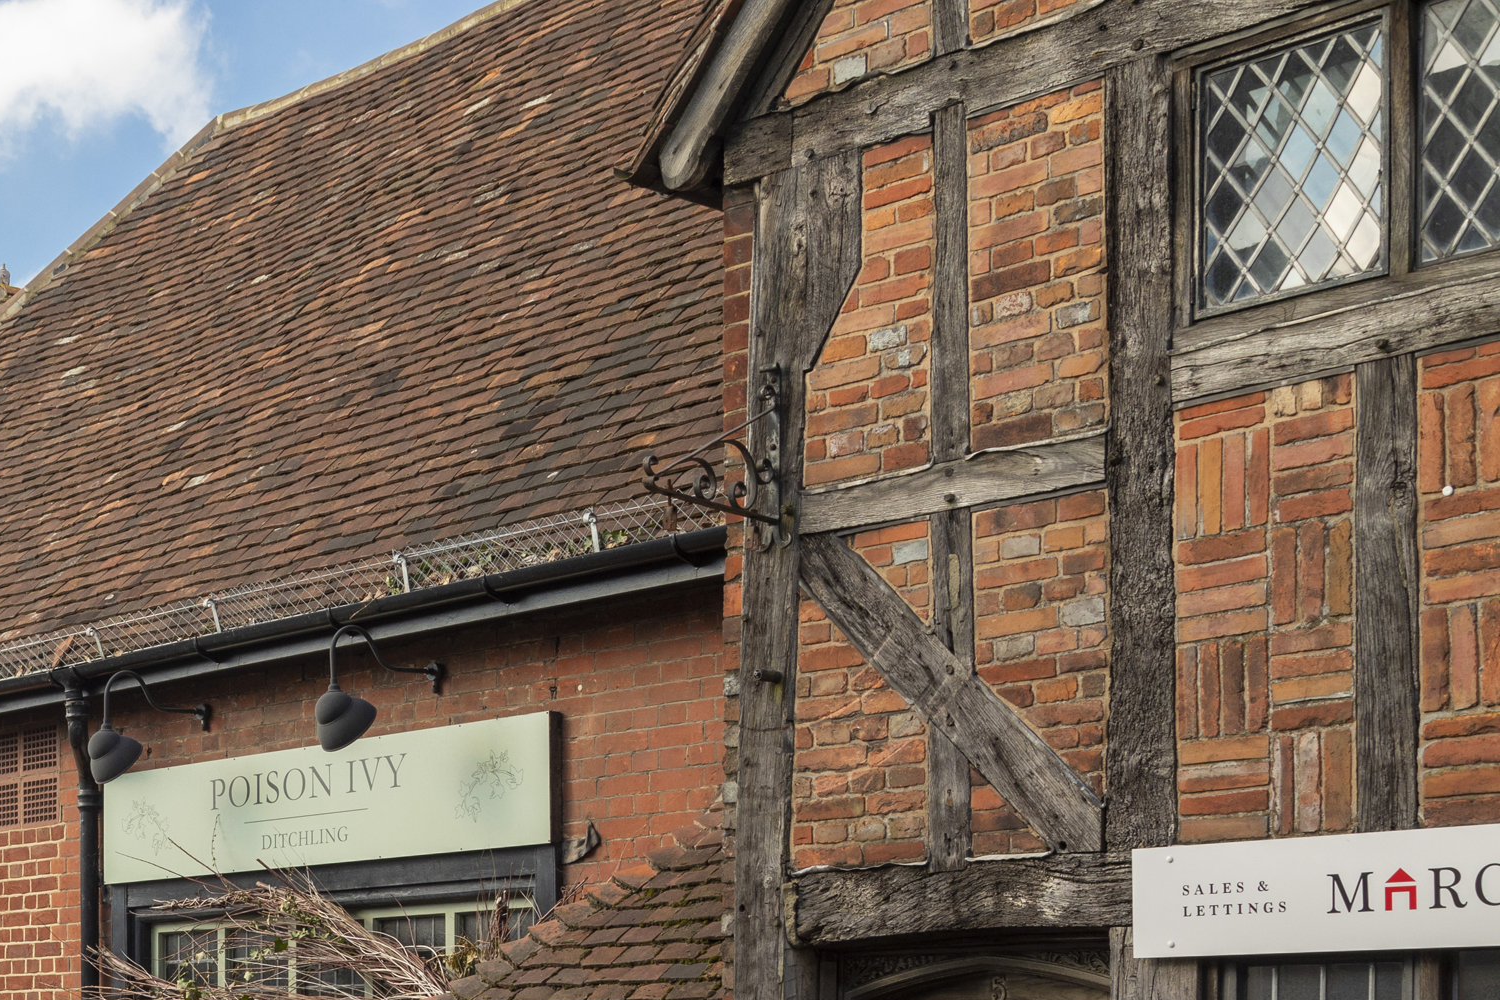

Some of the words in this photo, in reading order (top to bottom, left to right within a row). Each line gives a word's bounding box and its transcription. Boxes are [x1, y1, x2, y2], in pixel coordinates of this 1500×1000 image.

[210, 763, 334, 811] POISON
[346, 752, 407, 795] IVY
[261, 825, 349, 850] DITCHLING
[1182, 881, 1245, 896] SALES
[1257, 880, 1269, 893] &
[1183, 901, 1288, 917] LETTINGS
